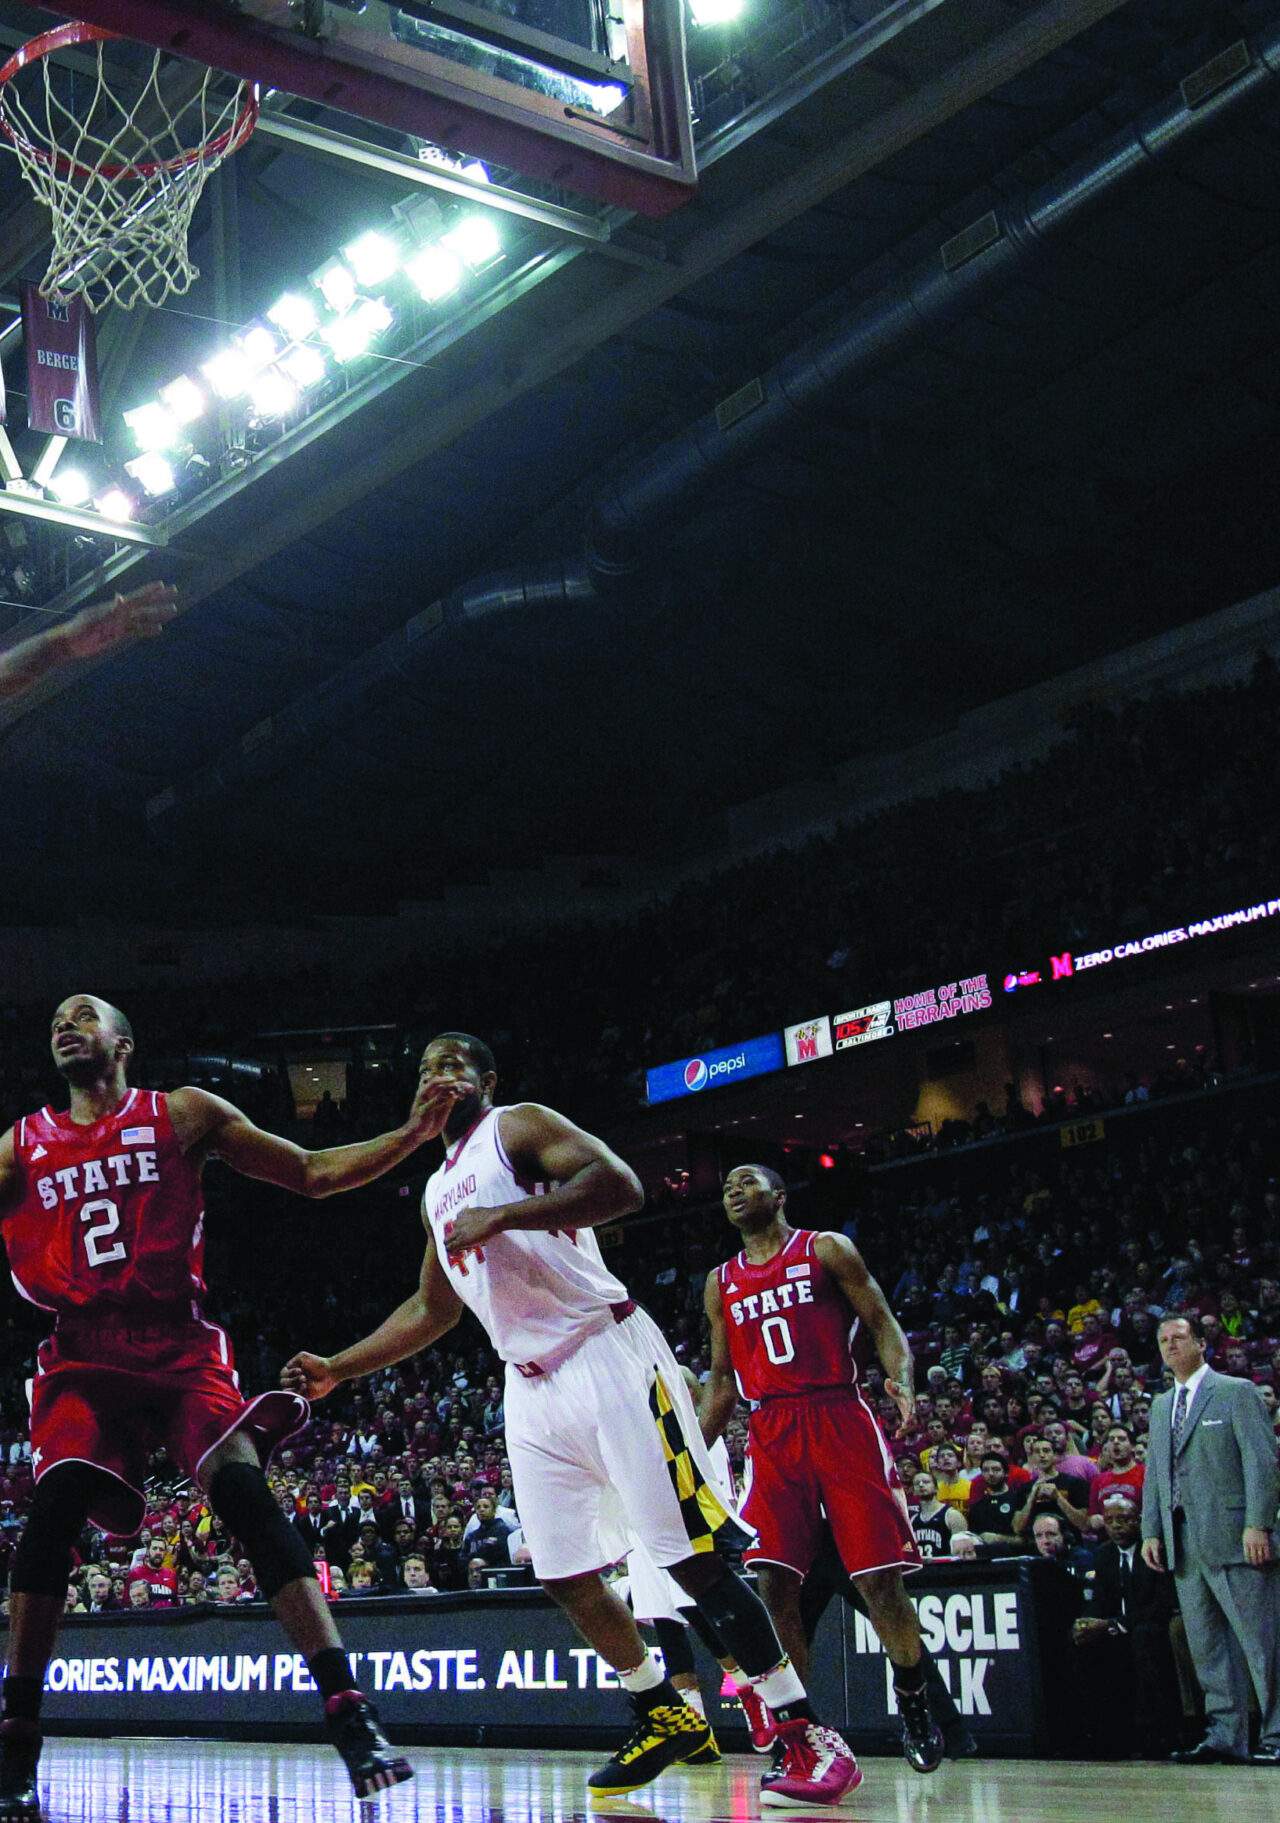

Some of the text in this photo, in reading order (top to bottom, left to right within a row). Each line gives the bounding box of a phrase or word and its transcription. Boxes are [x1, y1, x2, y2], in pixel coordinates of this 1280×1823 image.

[53, 398, 77, 431] 6
[1074, 949, 1113, 972] ZERO
[1188, 903, 1267, 938] MAXIMUM
[894, 974, 989, 1015] HOME OF THE
[894, 990, 993, 1032] TERRAPINS
[709, 1052, 747, 1080] pepsi
[36, 1150, 161, 1210] STATE
[79, 1198, 127, 1268] 2
[729, 1279, 815, 1326] STATE
[760, 1315, 796, 1366] 0
[854, 1592, 1020, 1654] MSCLE
[126, 1653, 268, 1692] MAXIMUM
[367, 1649, 486, 1691] TASTE.
[496, 1649, 569, 1690] ALL
